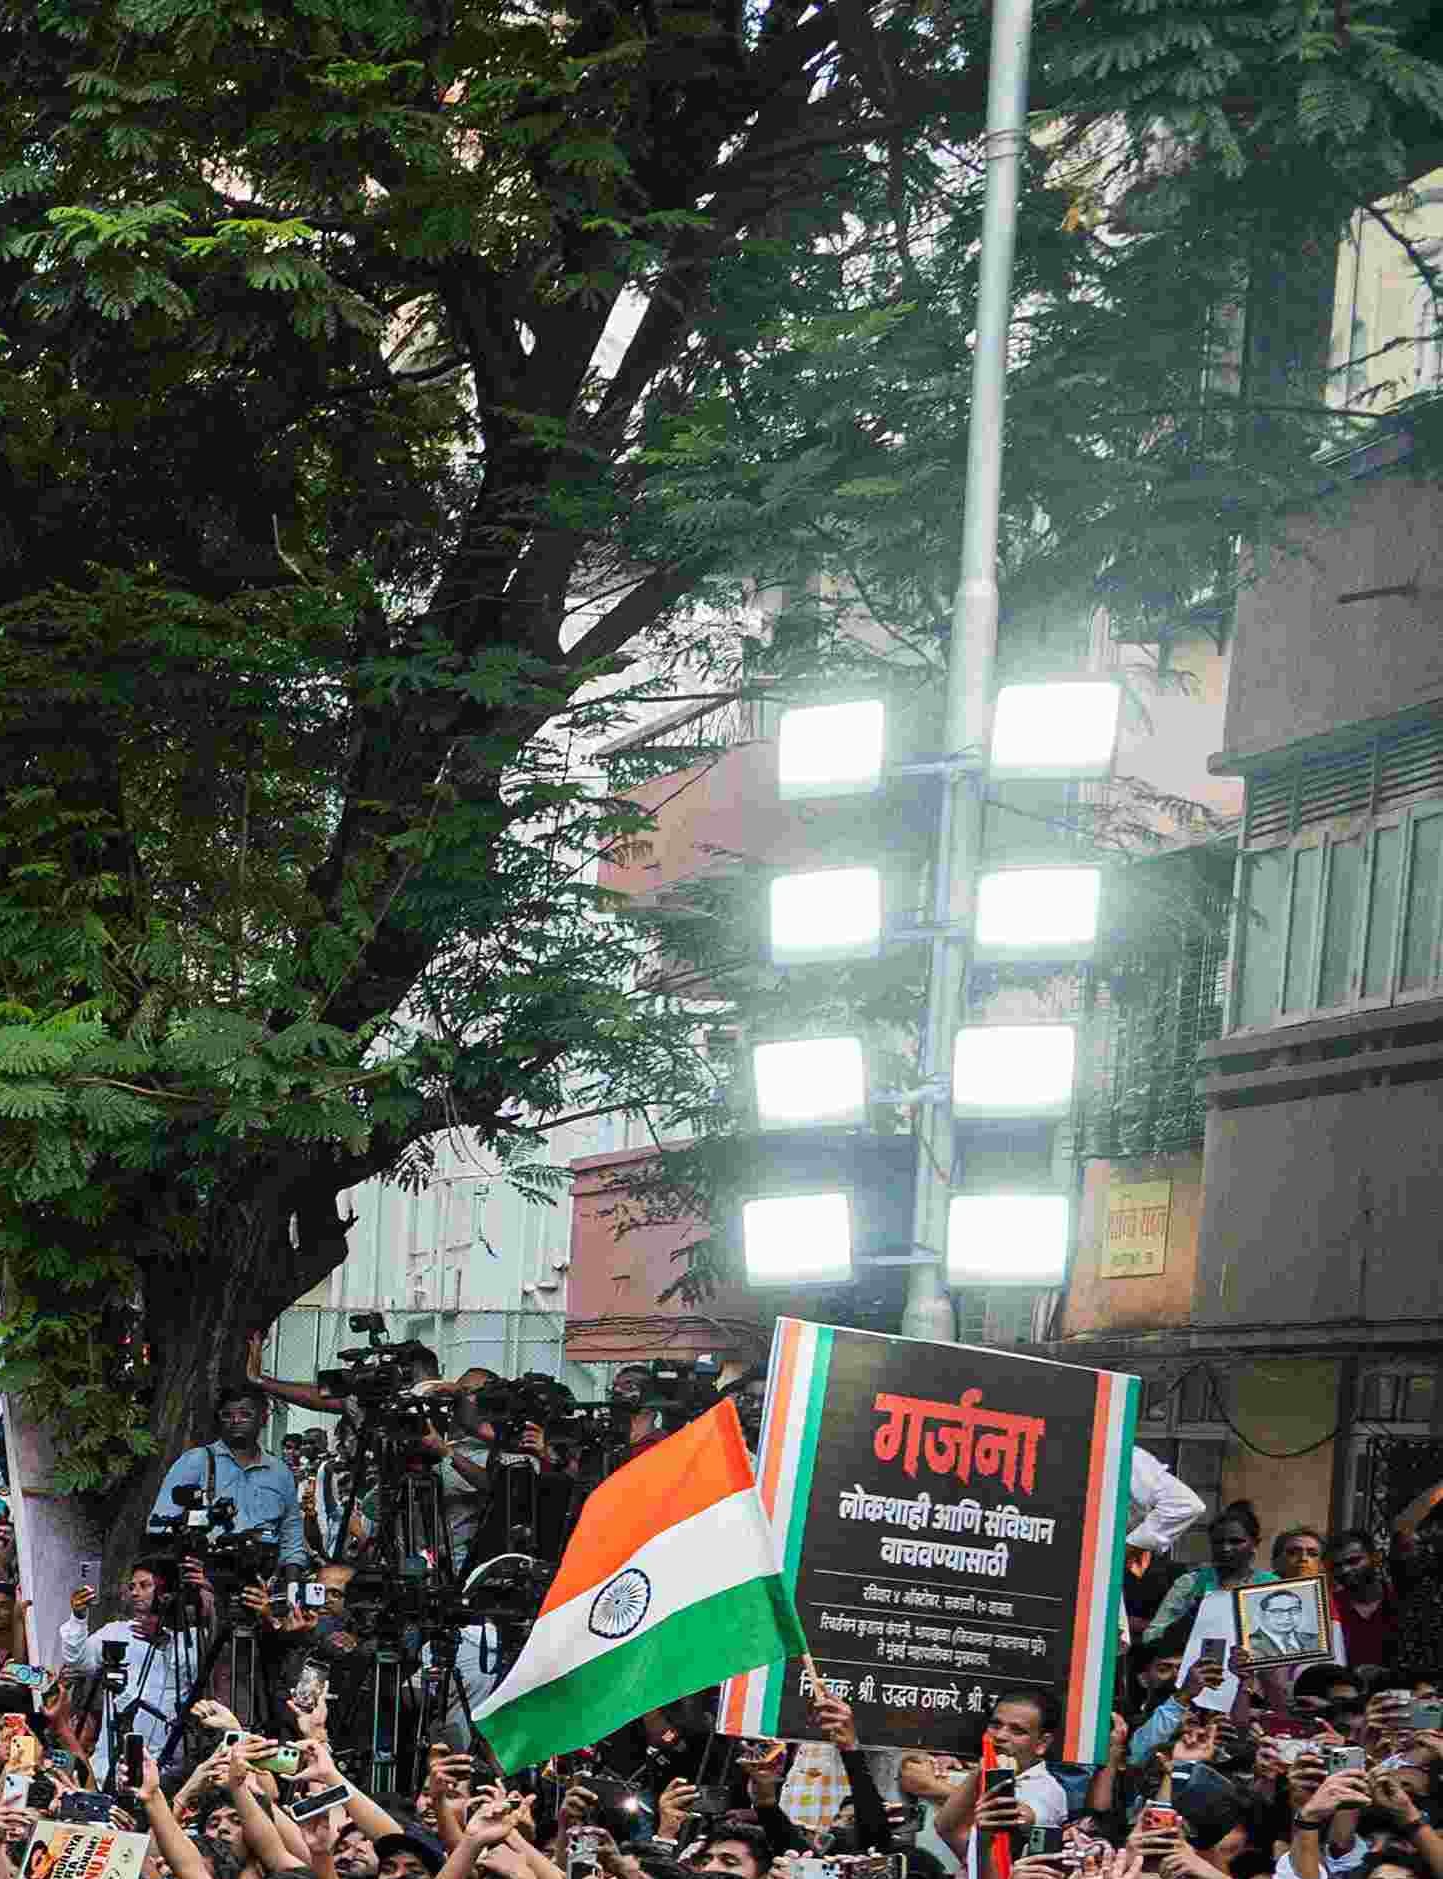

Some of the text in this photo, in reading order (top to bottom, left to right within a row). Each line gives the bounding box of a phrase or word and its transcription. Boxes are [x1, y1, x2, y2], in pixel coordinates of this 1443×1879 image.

[871, 1387, 1046, 1496] गर्जना
[838, 1483, 1056, 1545] लोकशाही आणि संविधान
[880, 1535, 1010, 1577] वाचवण्यासाठी
[857, 1675, 877, 1703] श्री.
[881, 1682, 918, 1708] उद्धव
